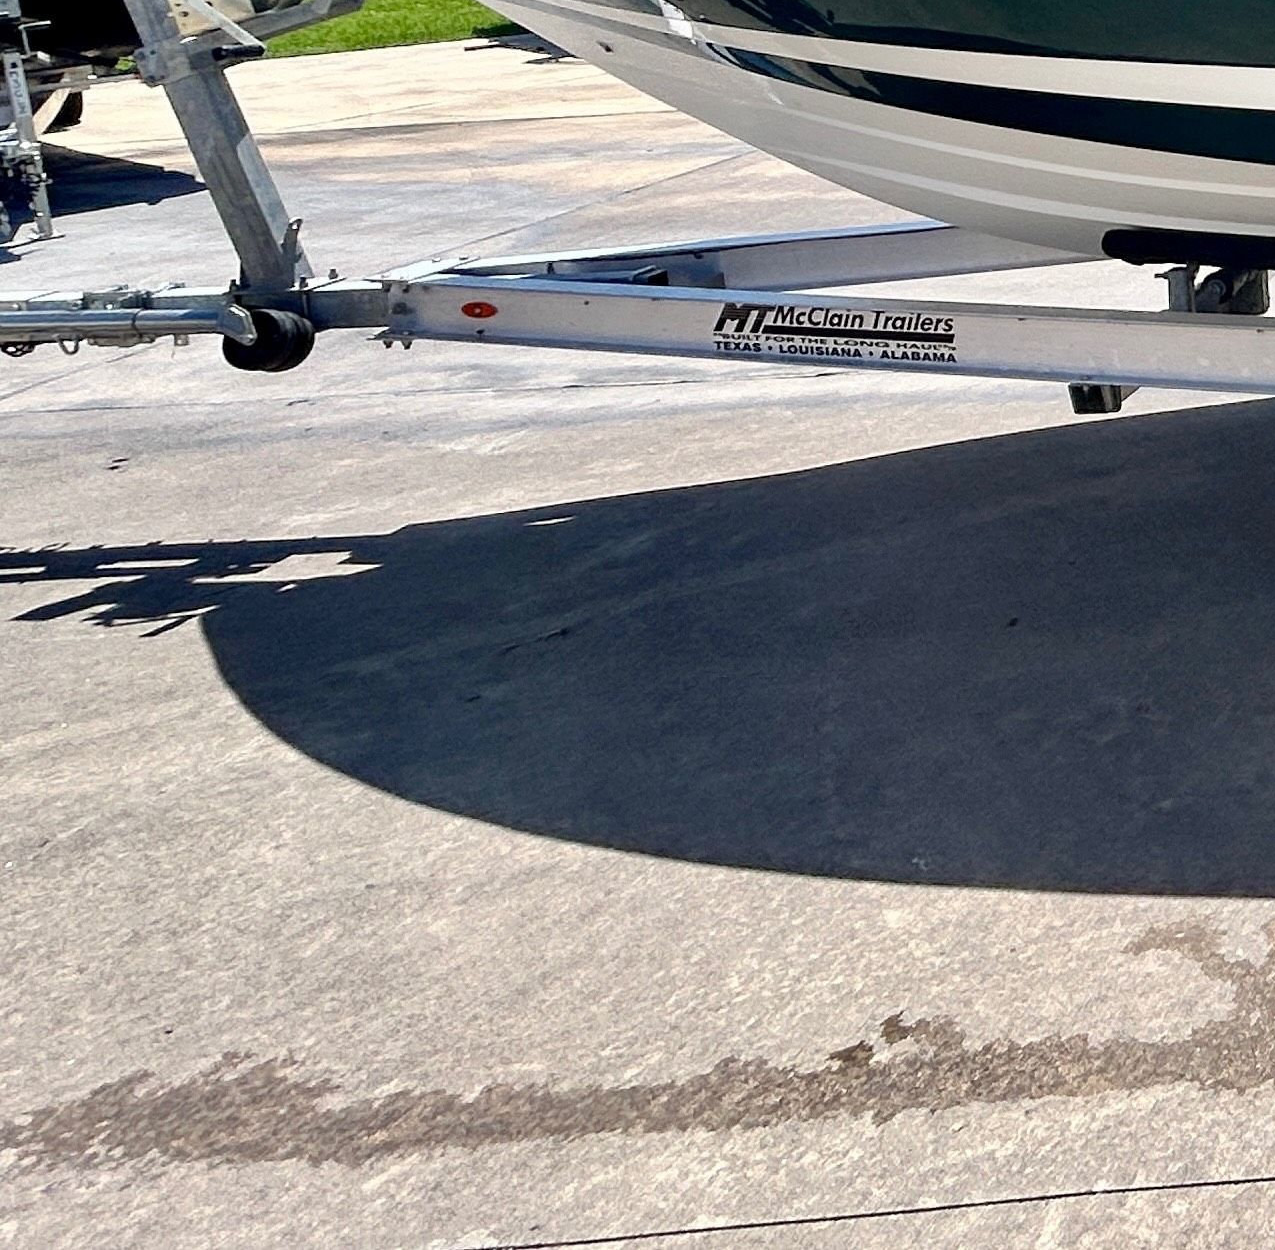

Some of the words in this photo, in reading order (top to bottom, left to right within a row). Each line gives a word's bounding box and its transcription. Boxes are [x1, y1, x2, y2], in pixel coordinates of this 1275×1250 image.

[773, 306, 864, 328] McClain
[872, 310, 954, 332] Trailers
[713, 340, 762, 353] TEXAS
[779, 344, 862, 357] LOUISIANA
[880, 350, 957, 363] ALABAMA
[766, 335, 795, 343] FOR
[800, 337, 828, 345] THE
[834, 339, 890, 348] LONG
